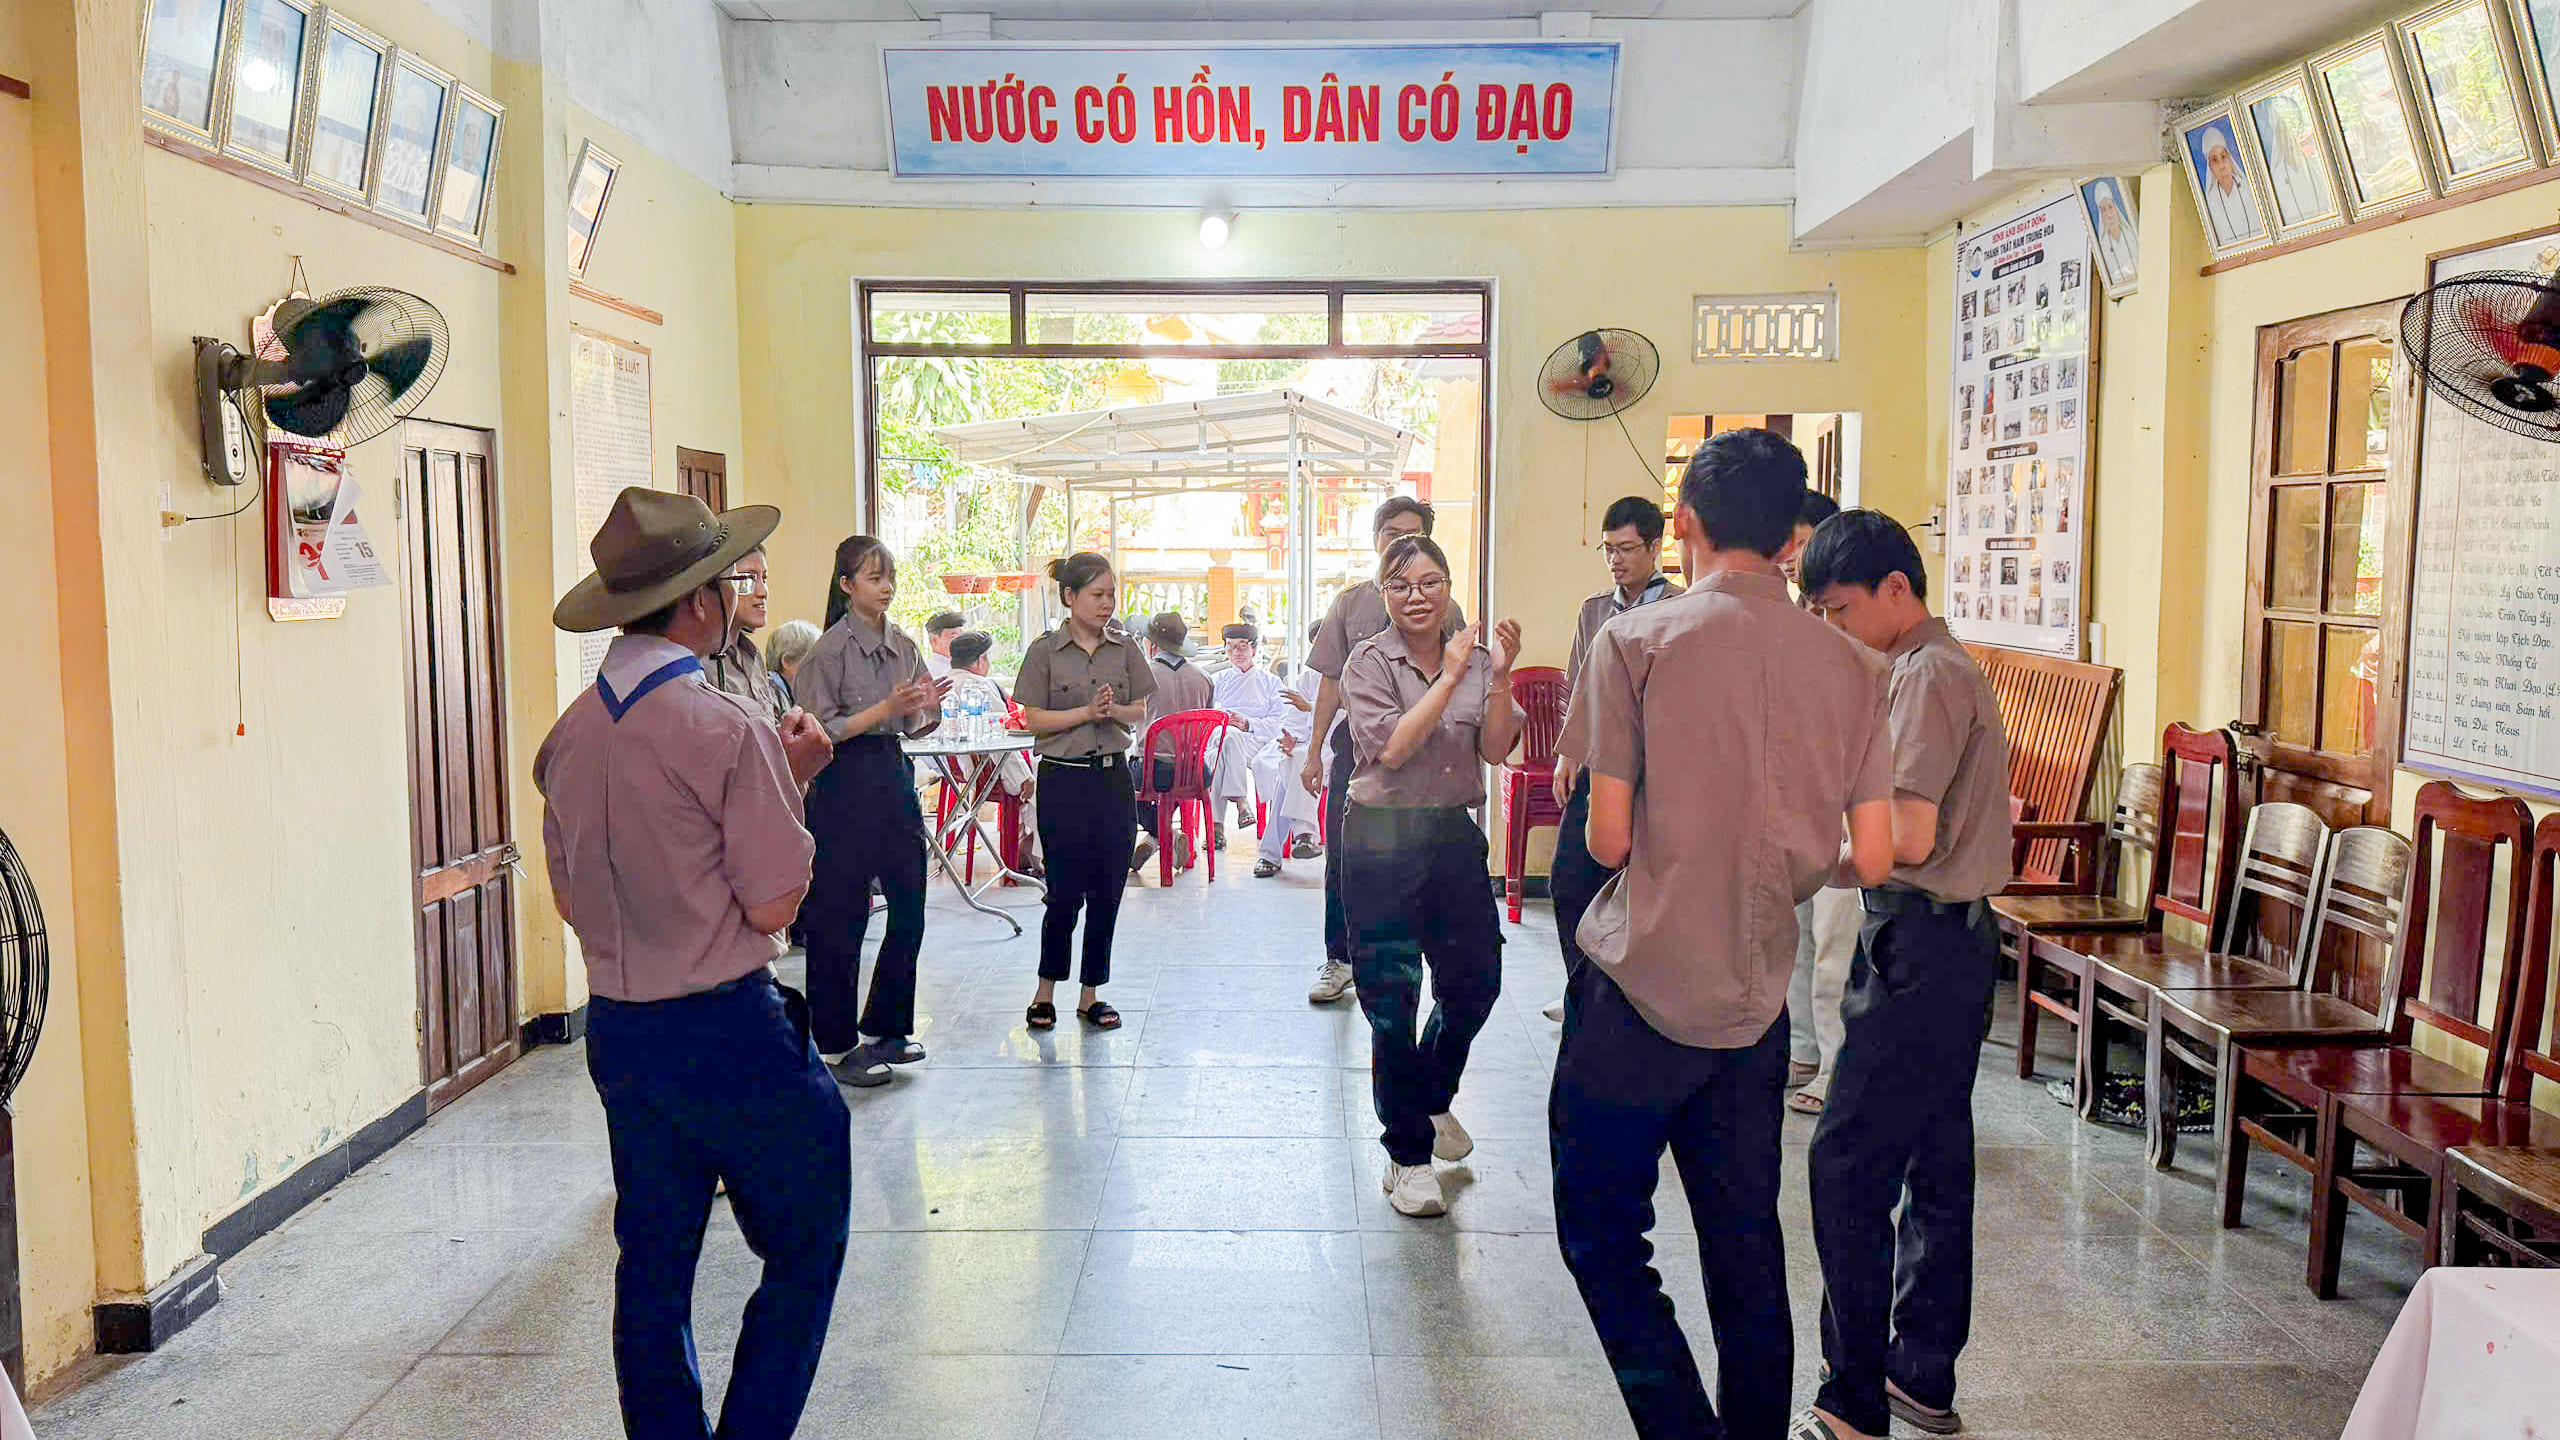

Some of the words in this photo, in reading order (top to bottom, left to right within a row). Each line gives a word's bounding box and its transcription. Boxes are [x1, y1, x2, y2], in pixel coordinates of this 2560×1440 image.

[926, 73, 1058, 143] NƯỚC
[1074, 73, 1137, 143] CÓ
[1153, 65, 1266, 150] HỒN,
[1283, 73, 1380, 142] DÂN
[1397, 71, 1459, 142] CÓ
[1476, 82, 1573, 153] ĐẠO
[355, 541, 374, 559] 15
